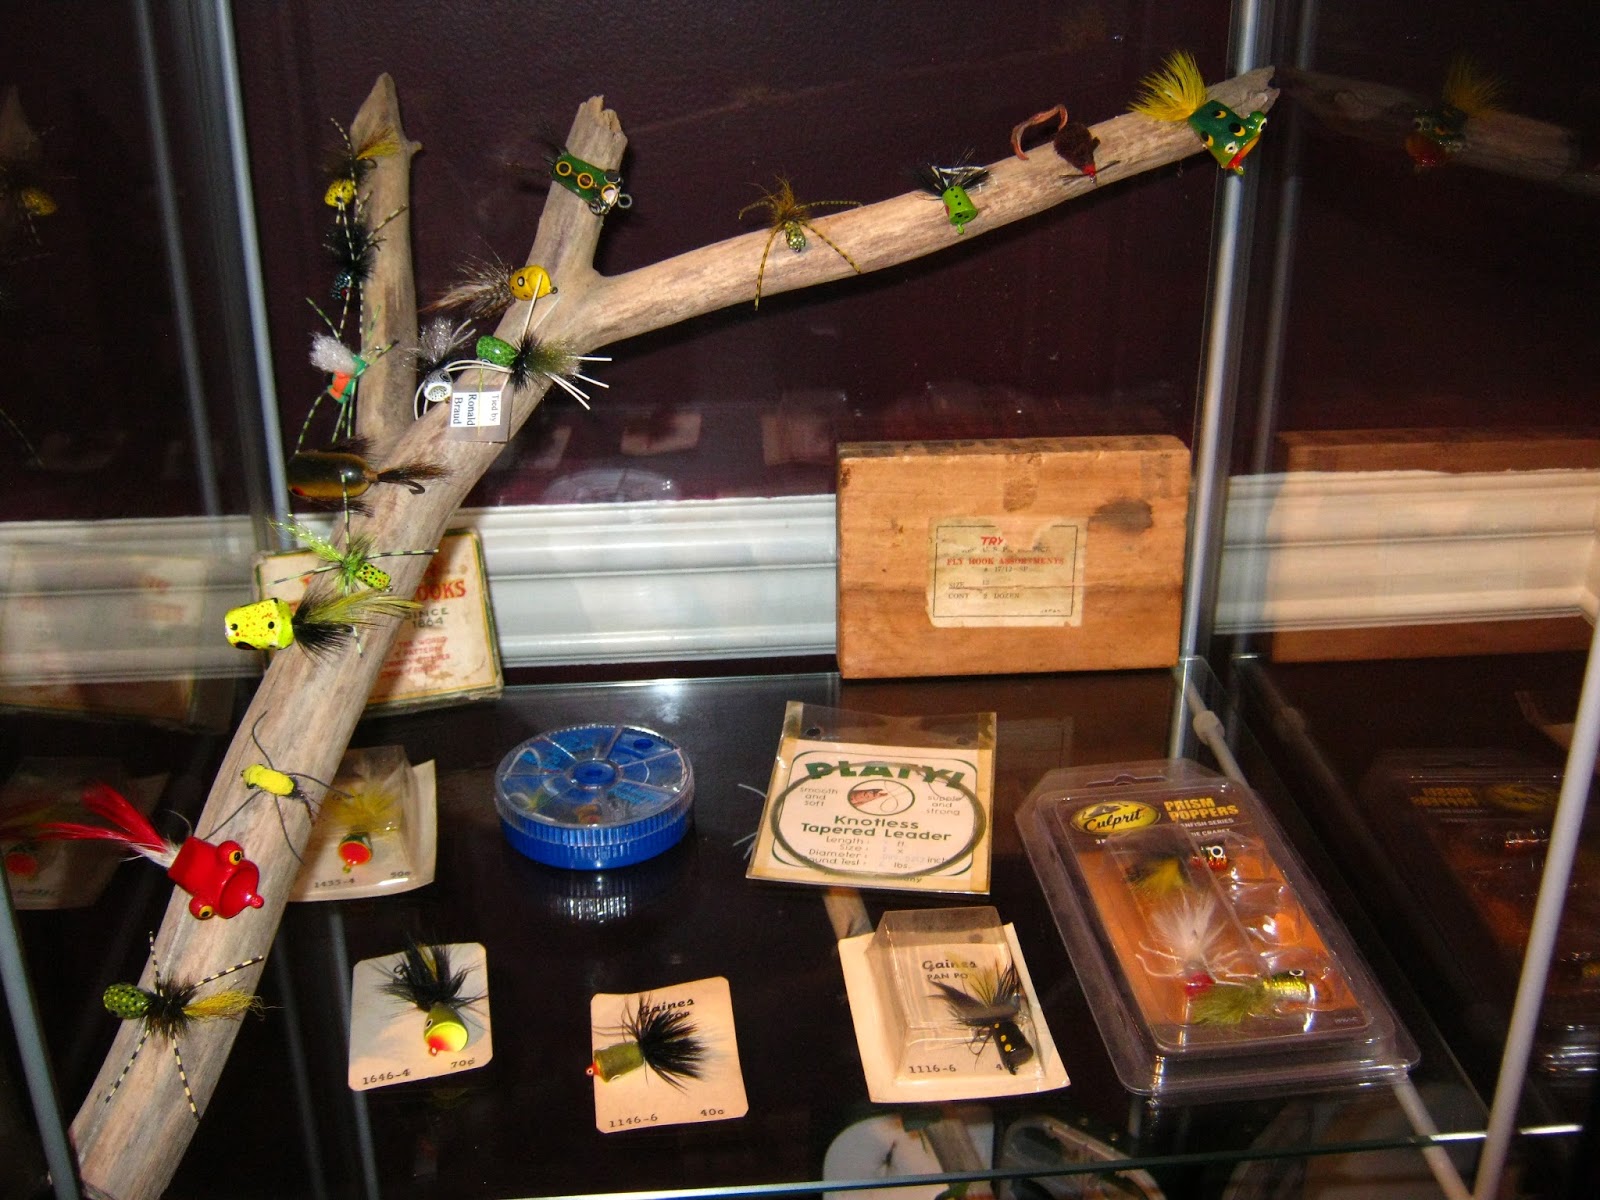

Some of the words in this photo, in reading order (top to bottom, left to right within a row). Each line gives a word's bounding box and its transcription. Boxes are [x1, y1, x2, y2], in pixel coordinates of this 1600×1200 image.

[452, 397, 464, 425] Braud
[466, 394, 477, 426] Ronald
[980, 536, 1004, 546] TRY
[946, 558, 963, 566] FLY
[968, 557, 994, 565] HOOK
[415, 579, 467, 602] OOKS
[412, 617, 444, 629] 1864
[804, 793, 826, 801] and
[804, 799, 825, 807] soft
[931, 801, 953, 809] and
[1163, 798, 1216, 811] PRISM
[926, 808, 961, 816] strong
[1168, 804, 1239, 822] POPPERS
[834, 814, 920, 830] Knotless
[1083, 808, 1142, 832] Culprit
[1207, 817, 1234, 826] SERIES
[800, 822, 876, 838] Tapered
[884, 827, 953, 842] Leader
[825, 836, 864, 846] Length
[839, 843, 862, 851] Size
[808, 848, 861, 859] Diameter
[841, 858, 860, 866] Test
[922, 959, 977, 972] Gaines
[908, 1064, 957, 1074] 1116-6
[362, 1068, 412, 1086] 1646-4
[608, 1114, 659, 1129] 1146-6
